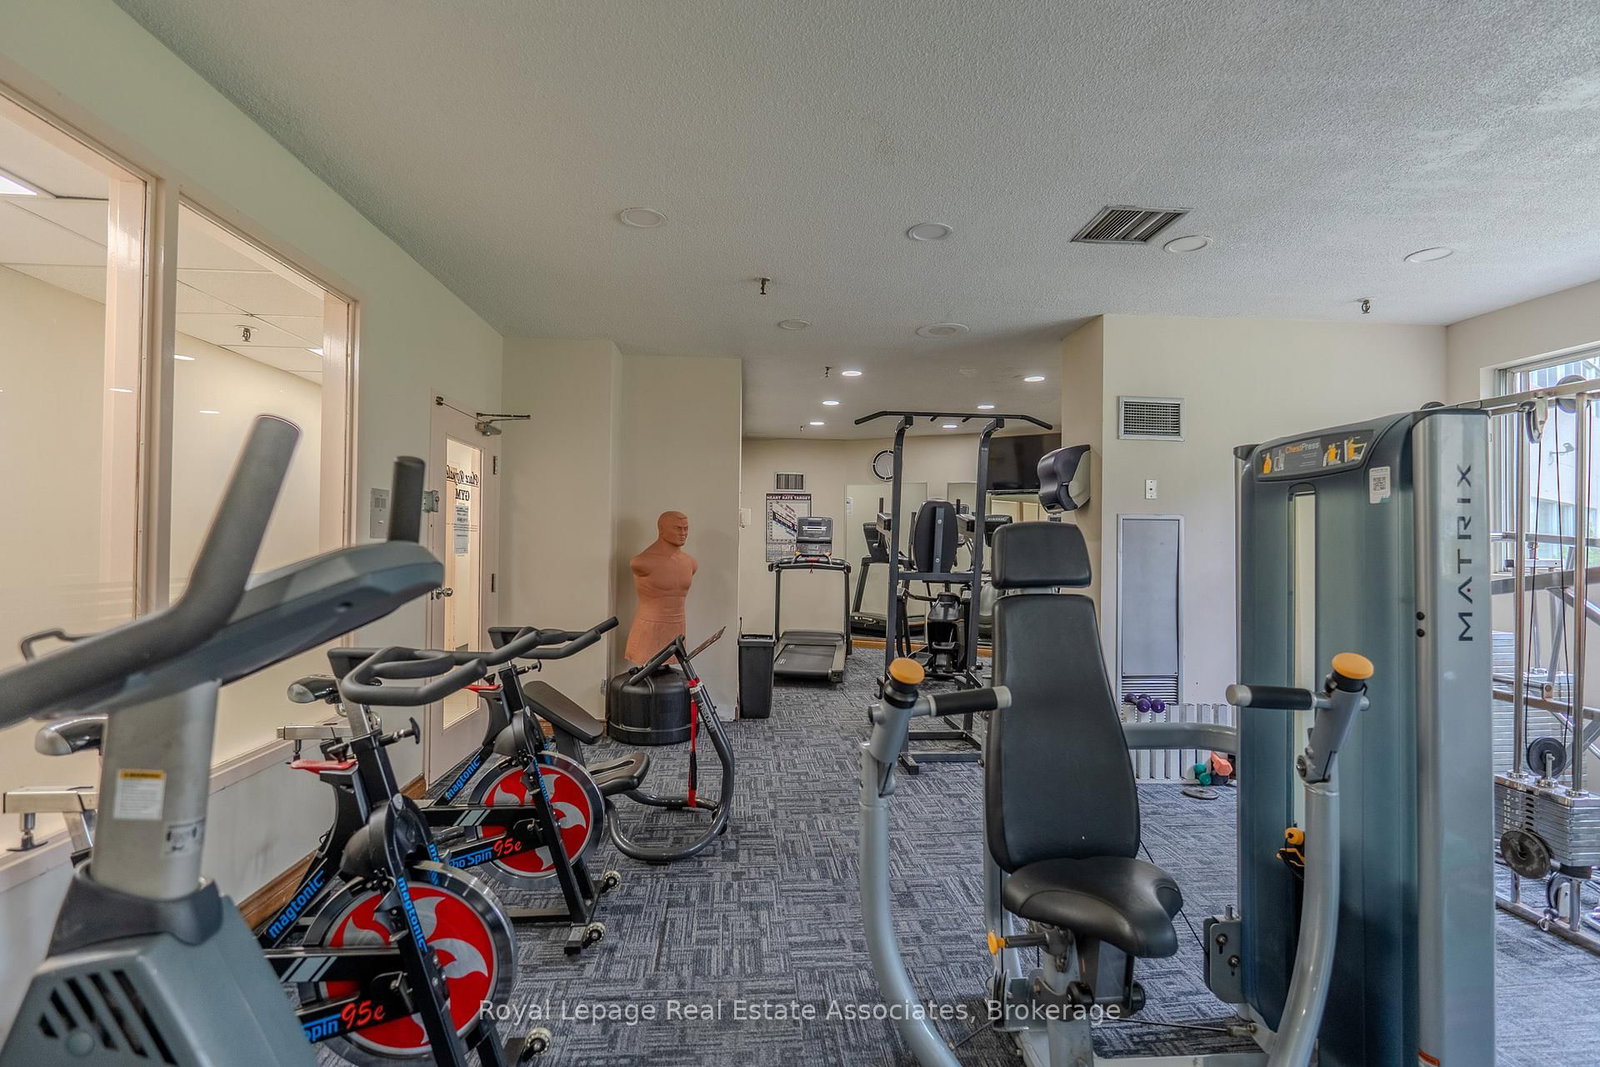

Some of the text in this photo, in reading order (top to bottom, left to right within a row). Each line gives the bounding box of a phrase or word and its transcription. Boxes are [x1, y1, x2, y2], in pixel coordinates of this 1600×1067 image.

[1457, 464, 1473, 641] MATRIX
[445, 755, 481, 801] magtonic
[493, 838, 522, 857] 95e
[267, 869, 326, 940] magtonic
[397, 876, 429, 953] magtonic
[341, 1000, 385, 1030] 95e
